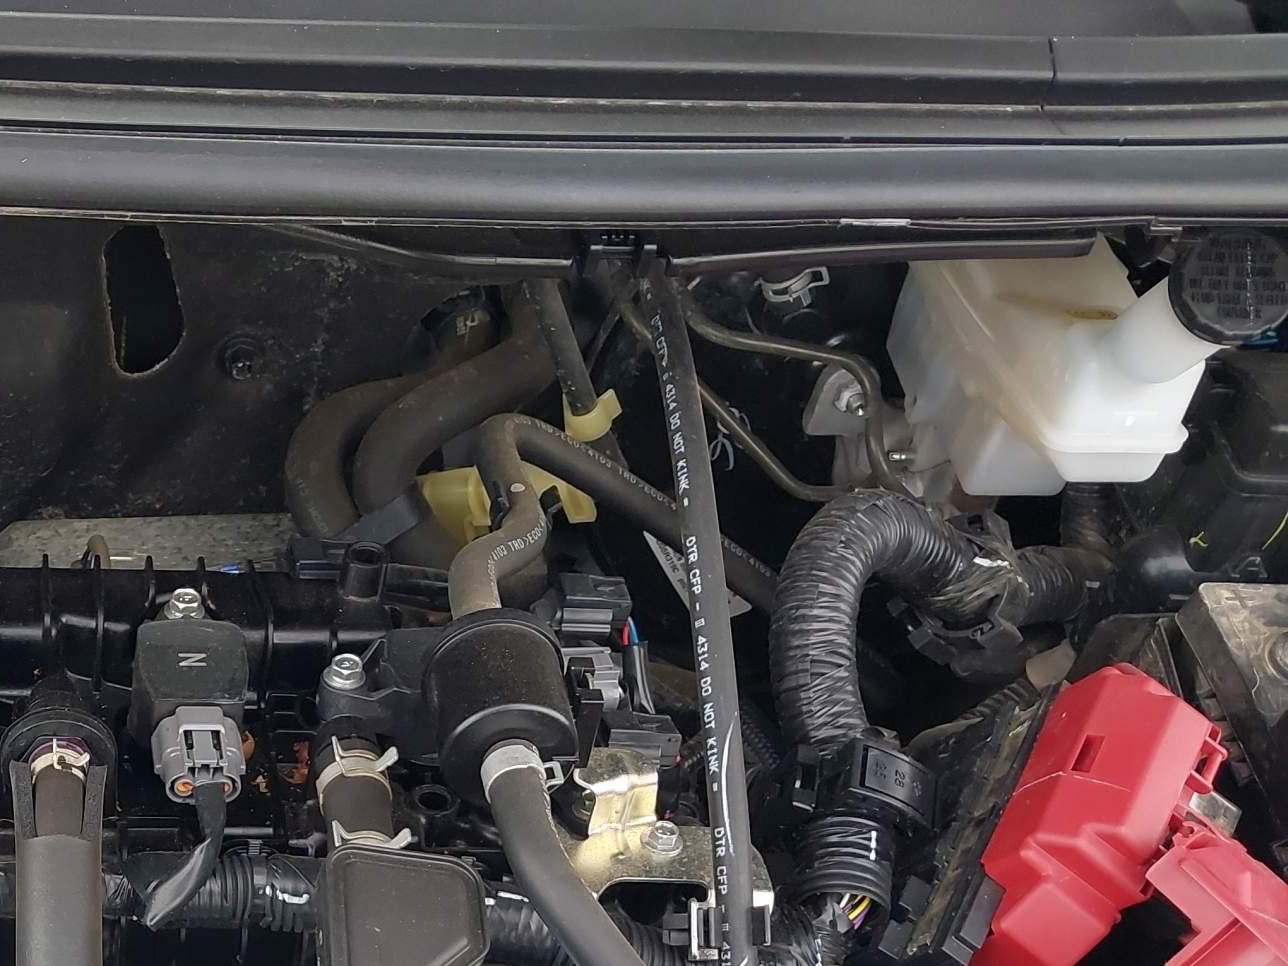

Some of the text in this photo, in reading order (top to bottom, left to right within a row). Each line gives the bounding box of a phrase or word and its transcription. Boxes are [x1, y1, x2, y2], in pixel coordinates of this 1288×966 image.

[672, 432, 686, 456] NOT
[676, 457, 690, 497] KINK
[688, 565, 703, 596] CFP
[696, 634, 710, 666] 4314
[700, 675, 713, 697] DO
[703, 702, 716, 731] NOT
[707, 735, 719, 774] KINK
[716, 865, 728, 896] CFP
